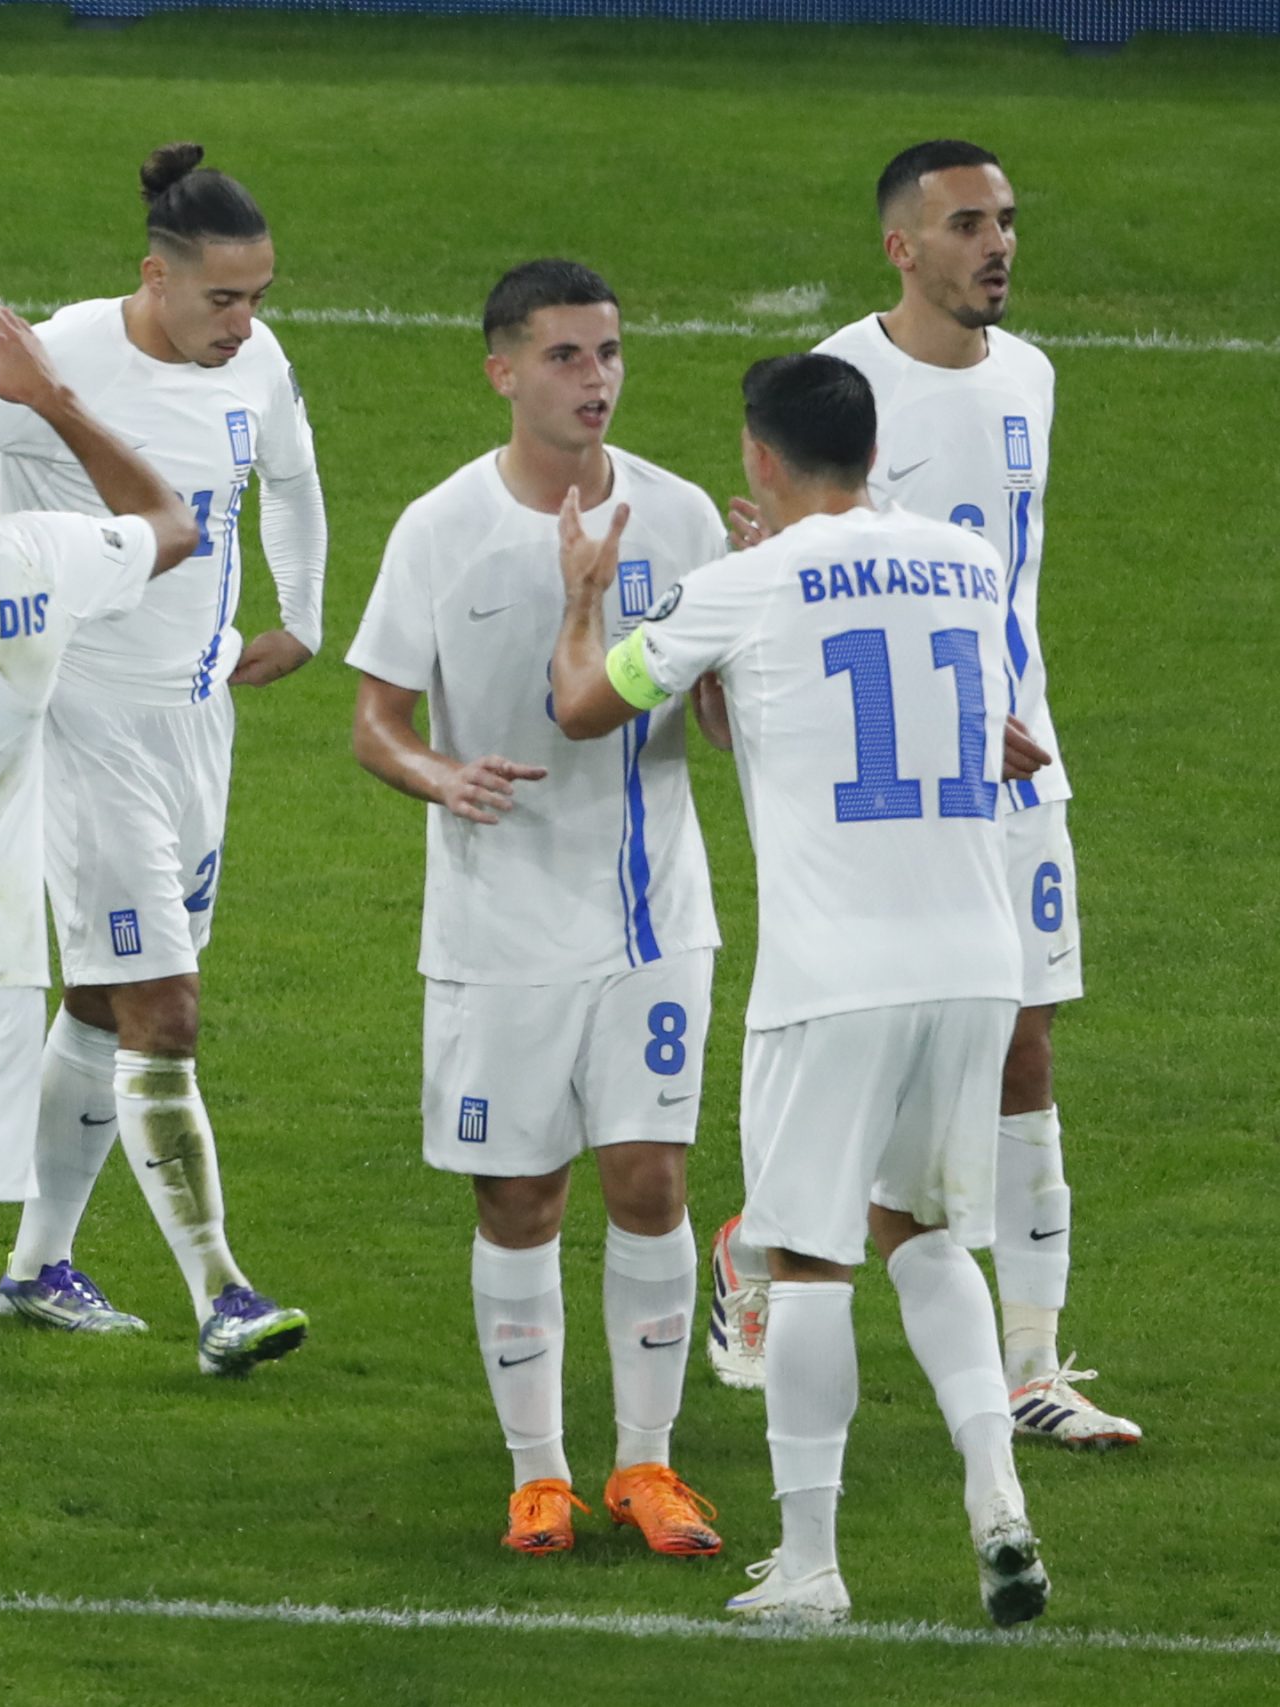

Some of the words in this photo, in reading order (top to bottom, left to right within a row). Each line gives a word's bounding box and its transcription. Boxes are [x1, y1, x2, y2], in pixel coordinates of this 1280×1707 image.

[174, 490, 214, 557] 1
[799, 558, 999, 604] BAKASETAS
[821, 627, 999, 823] 11
[1032, 862, 1063, 932] 6
[645, 1001, 687, 1075] 8
